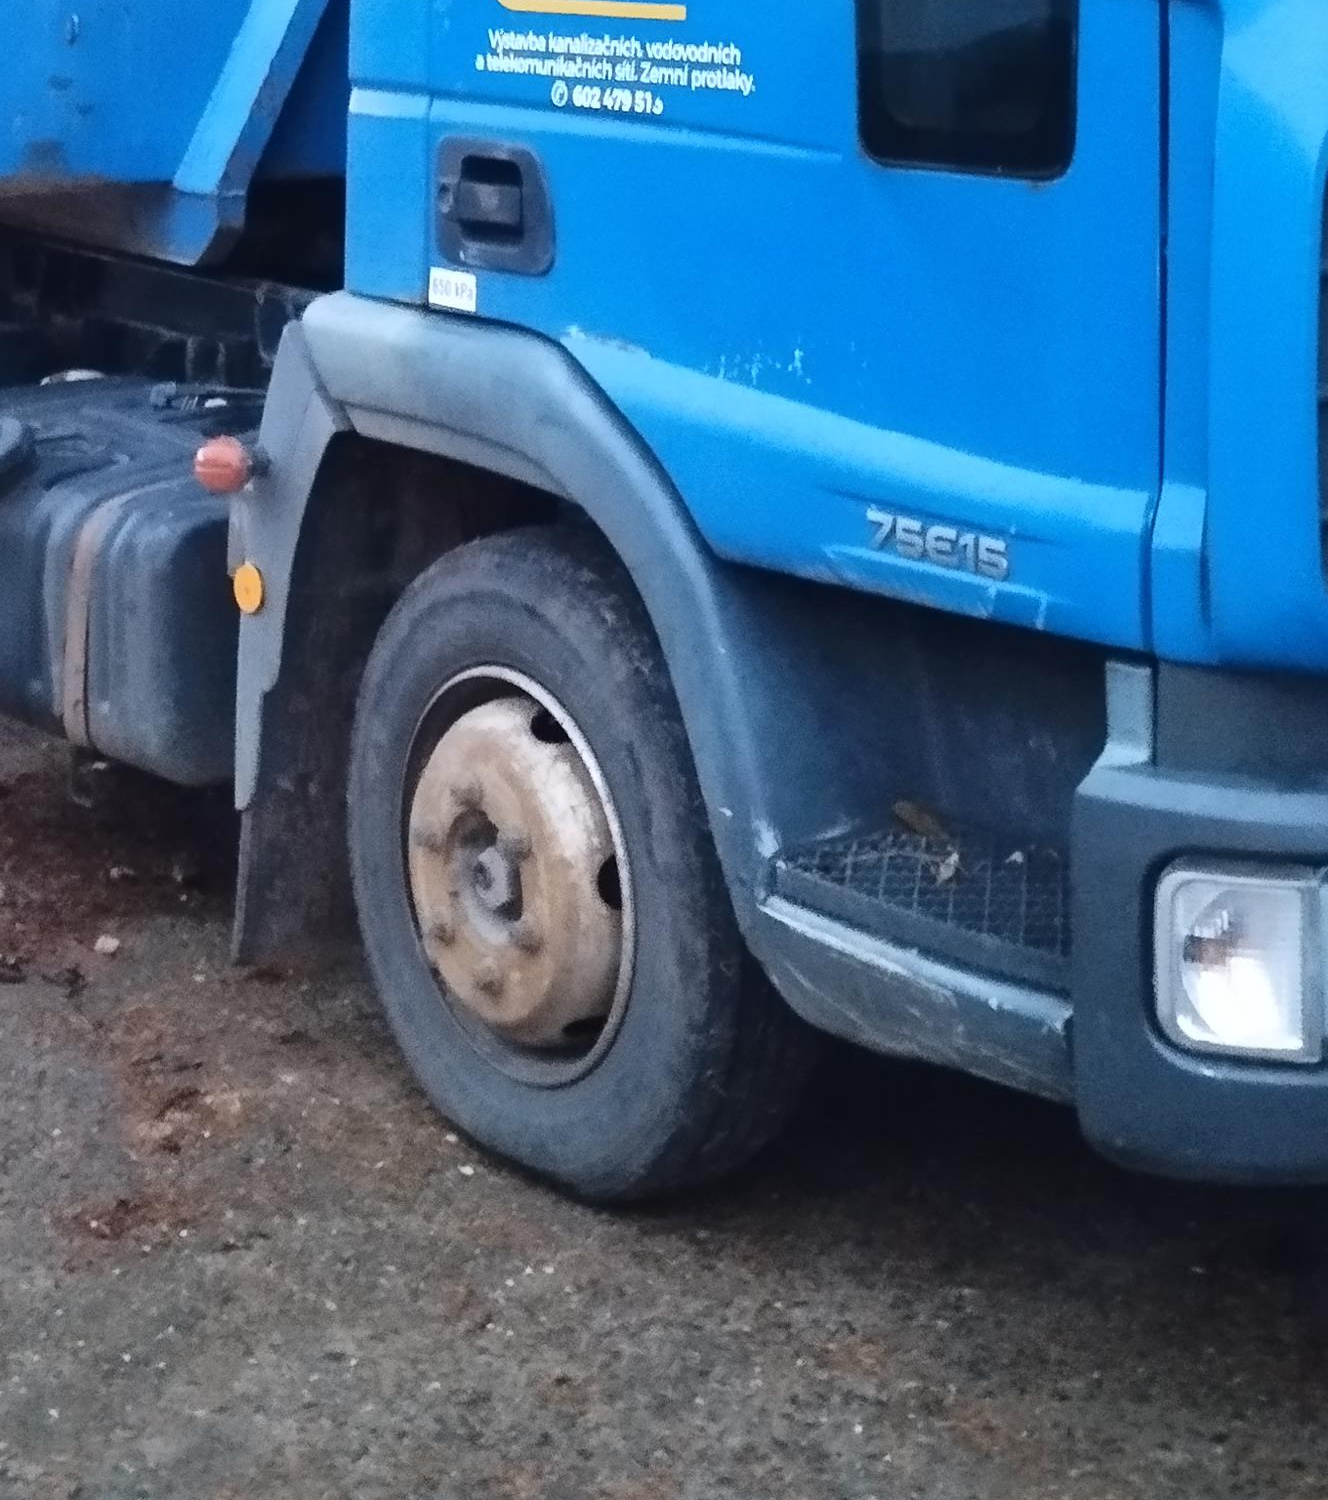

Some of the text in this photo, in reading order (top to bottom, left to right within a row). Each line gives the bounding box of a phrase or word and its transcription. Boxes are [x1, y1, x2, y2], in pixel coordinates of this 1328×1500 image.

[488, 28, 547, 53] Výstavba
[645, 38, 741, 66] vodovodních
[475, 53, 485, 71] a
[639, 61, 689, 86] Zemní
[866, 504, 1009, 582] 75E15
